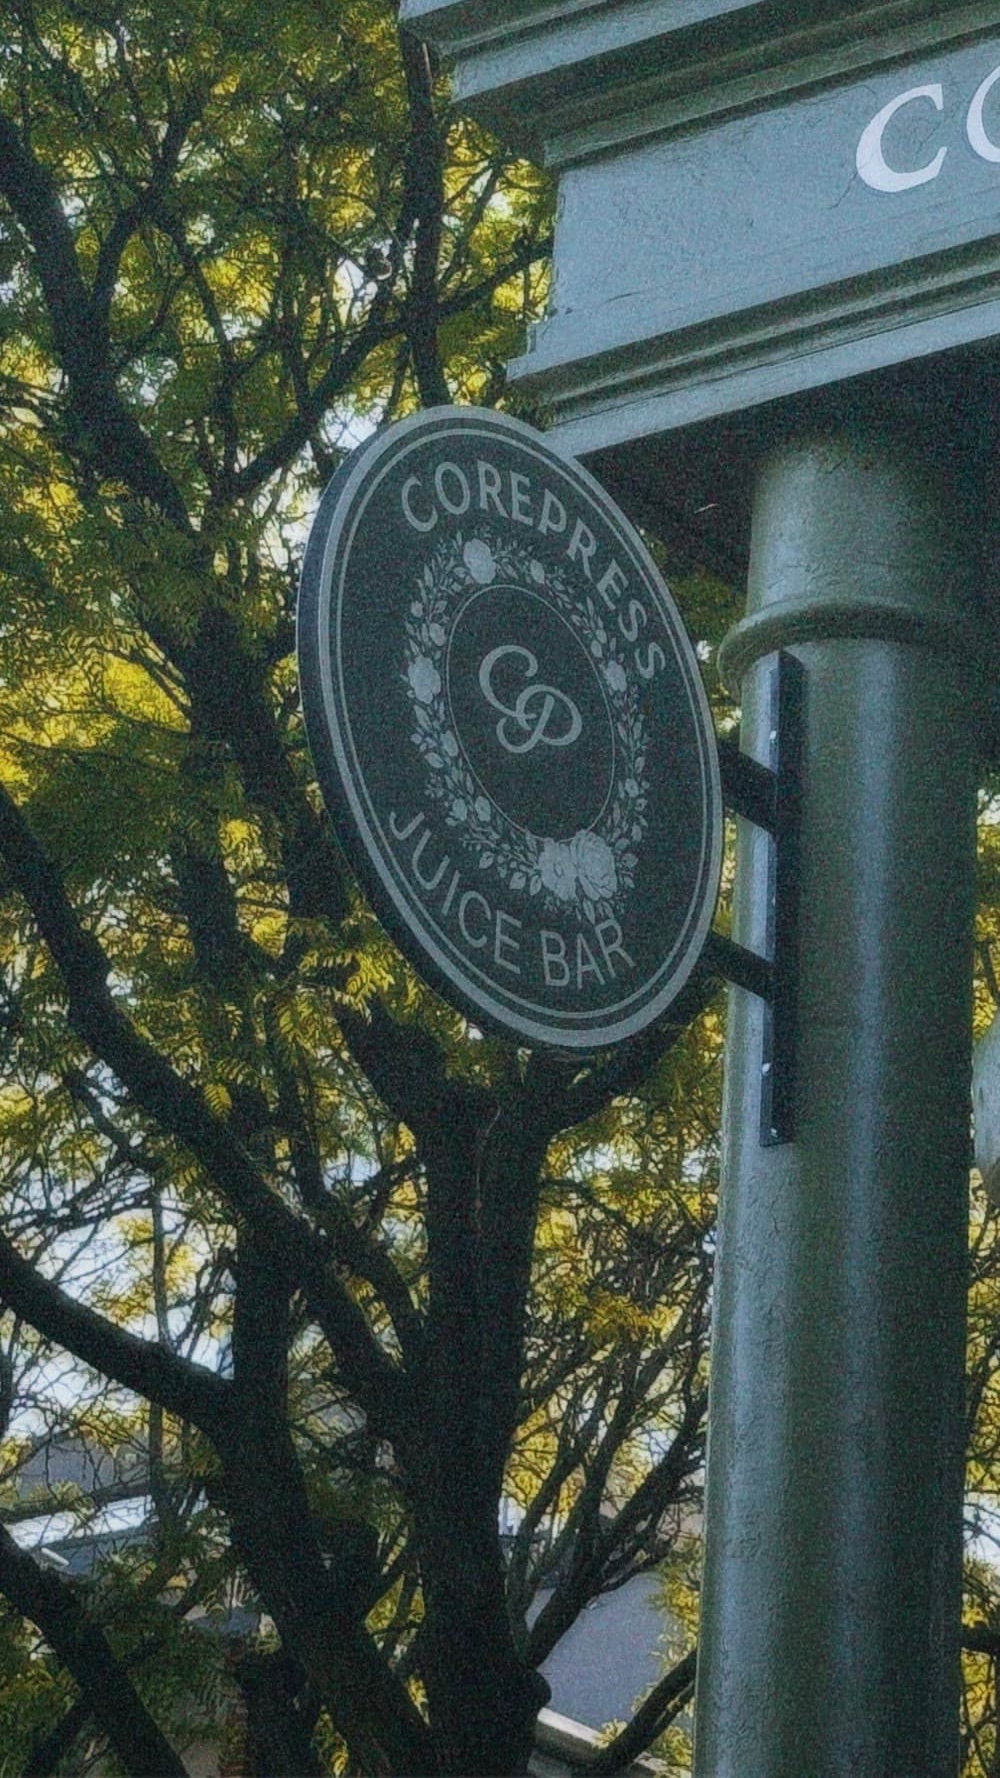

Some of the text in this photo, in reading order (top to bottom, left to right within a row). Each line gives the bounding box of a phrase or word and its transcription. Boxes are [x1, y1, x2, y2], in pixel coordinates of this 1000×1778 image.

[401, 460, 666, 680] COREPRESS
[388, 809, 635, 990] JUICE BAR
